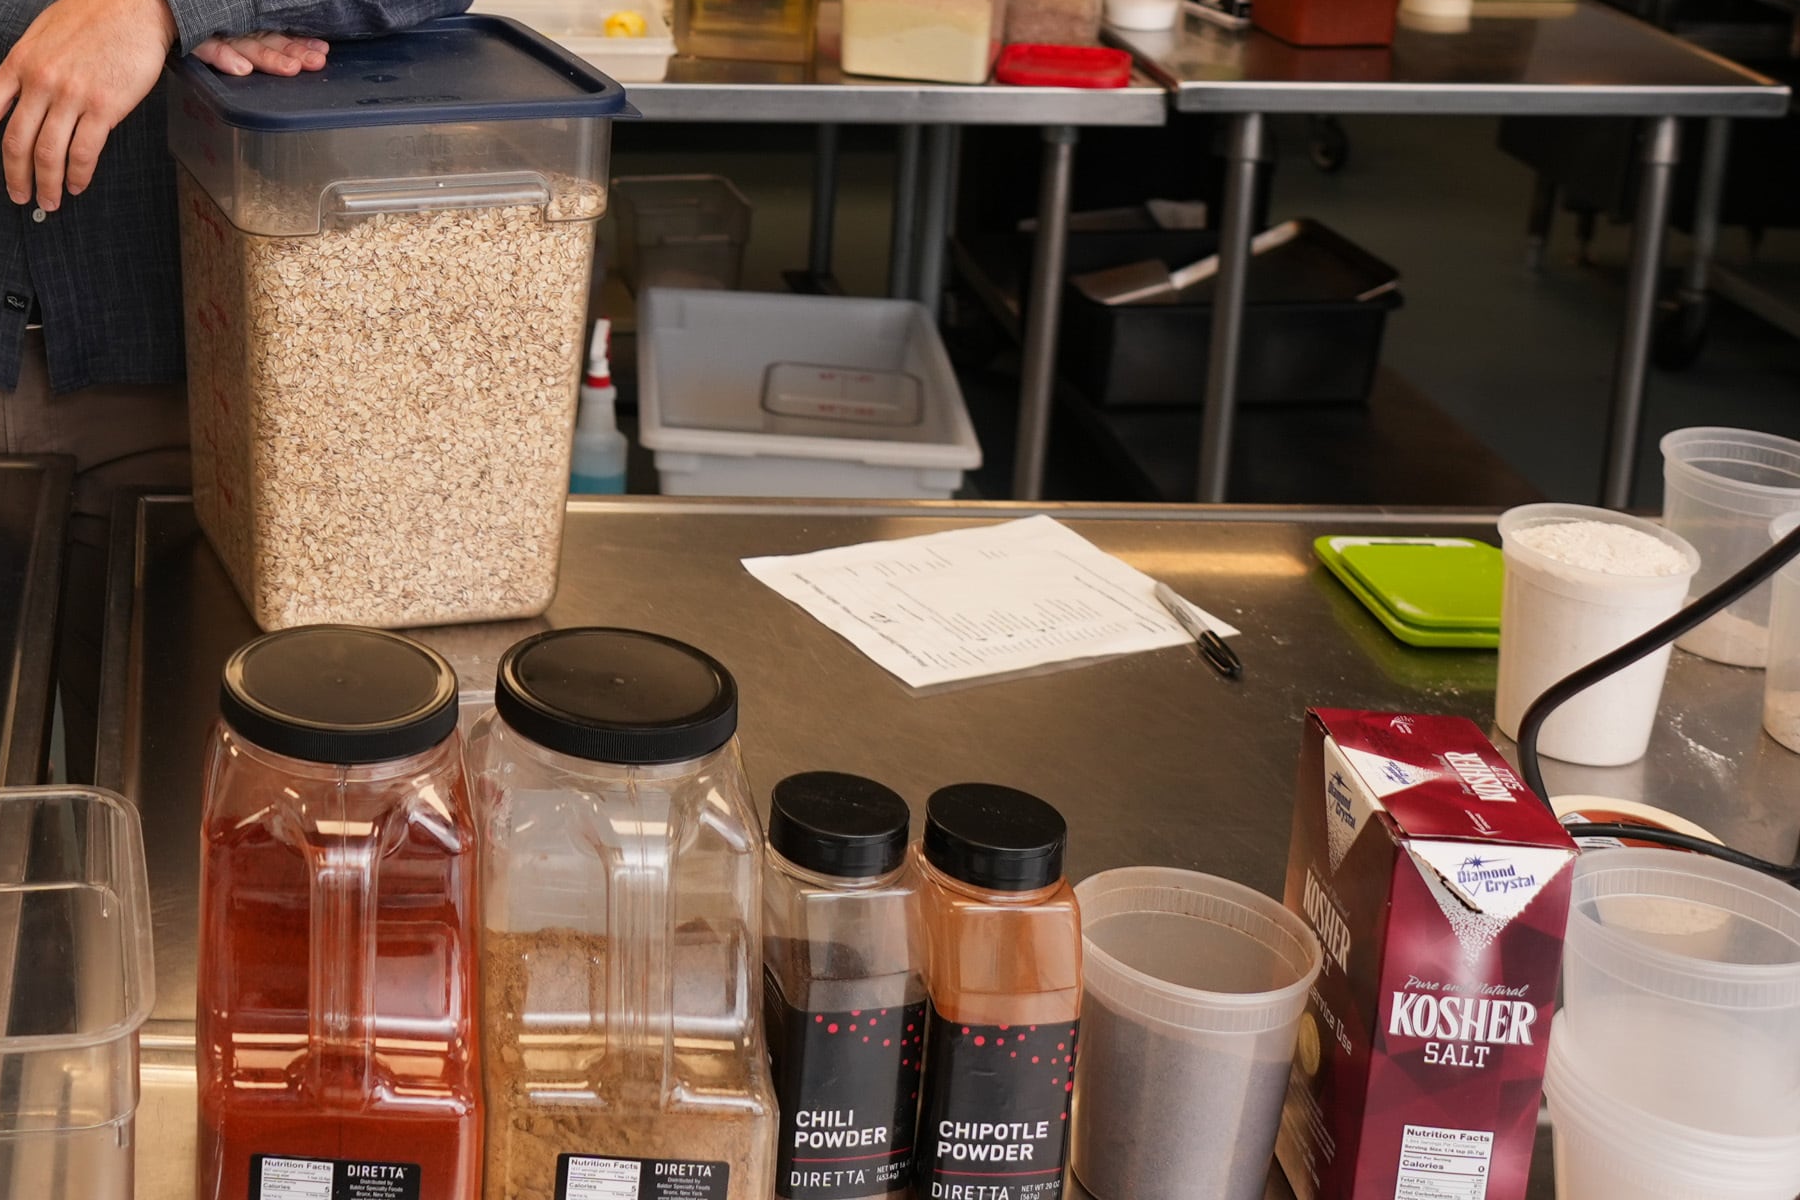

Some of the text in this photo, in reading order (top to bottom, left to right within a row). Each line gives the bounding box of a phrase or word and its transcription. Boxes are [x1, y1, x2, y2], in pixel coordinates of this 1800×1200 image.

[1444, 751, 1517, 803] KOSHER
[1457, 864, 1516, 884] Diamond
[1485, 874, 1536, 896] Crystal
[1303, 868, 1350, 976] KOSHER
[1404, 975, 1438, 991] Pure
[1388, 991, 1537, 1046] KOSHER
[1336, 1018, 1353, 1056] Use
[1424, 1042, 1490, 1068] SALT
[796, 1110, 854, 1128] CHILI
[794, 1127, 887, 1148] POWDER
[939, 1121, 1049, 1140] CHIPOTLE
[1407, 1128, 1490, 1142] Nutrition Facts
[937, 1141, 1033, 1161] POWDER
[264, 1160, 331, 1171] Nutrition Facts
[347, 1165, 405, 1179] DIRETTA
[571, 1159, 638, 1170] Nutrition Facts
[655, 1163, 712, 1177] DIRETTA
[877, 1165, 888, 1173] NET
[890, 1162, 898, 1171] WT
[1402, 1160, 1444, 1170] Calories
[263, 1182, 291, 1190] Calories
[569, 1182, 596, 1190] Calories
[790, 1169, 865, 1187] DIRETTA
[1035, 1183, 1044, 1191] WT
[1045, 1182, 1052, 1190] 20
[932, 1182, 1008, 1200] DIRETTA
